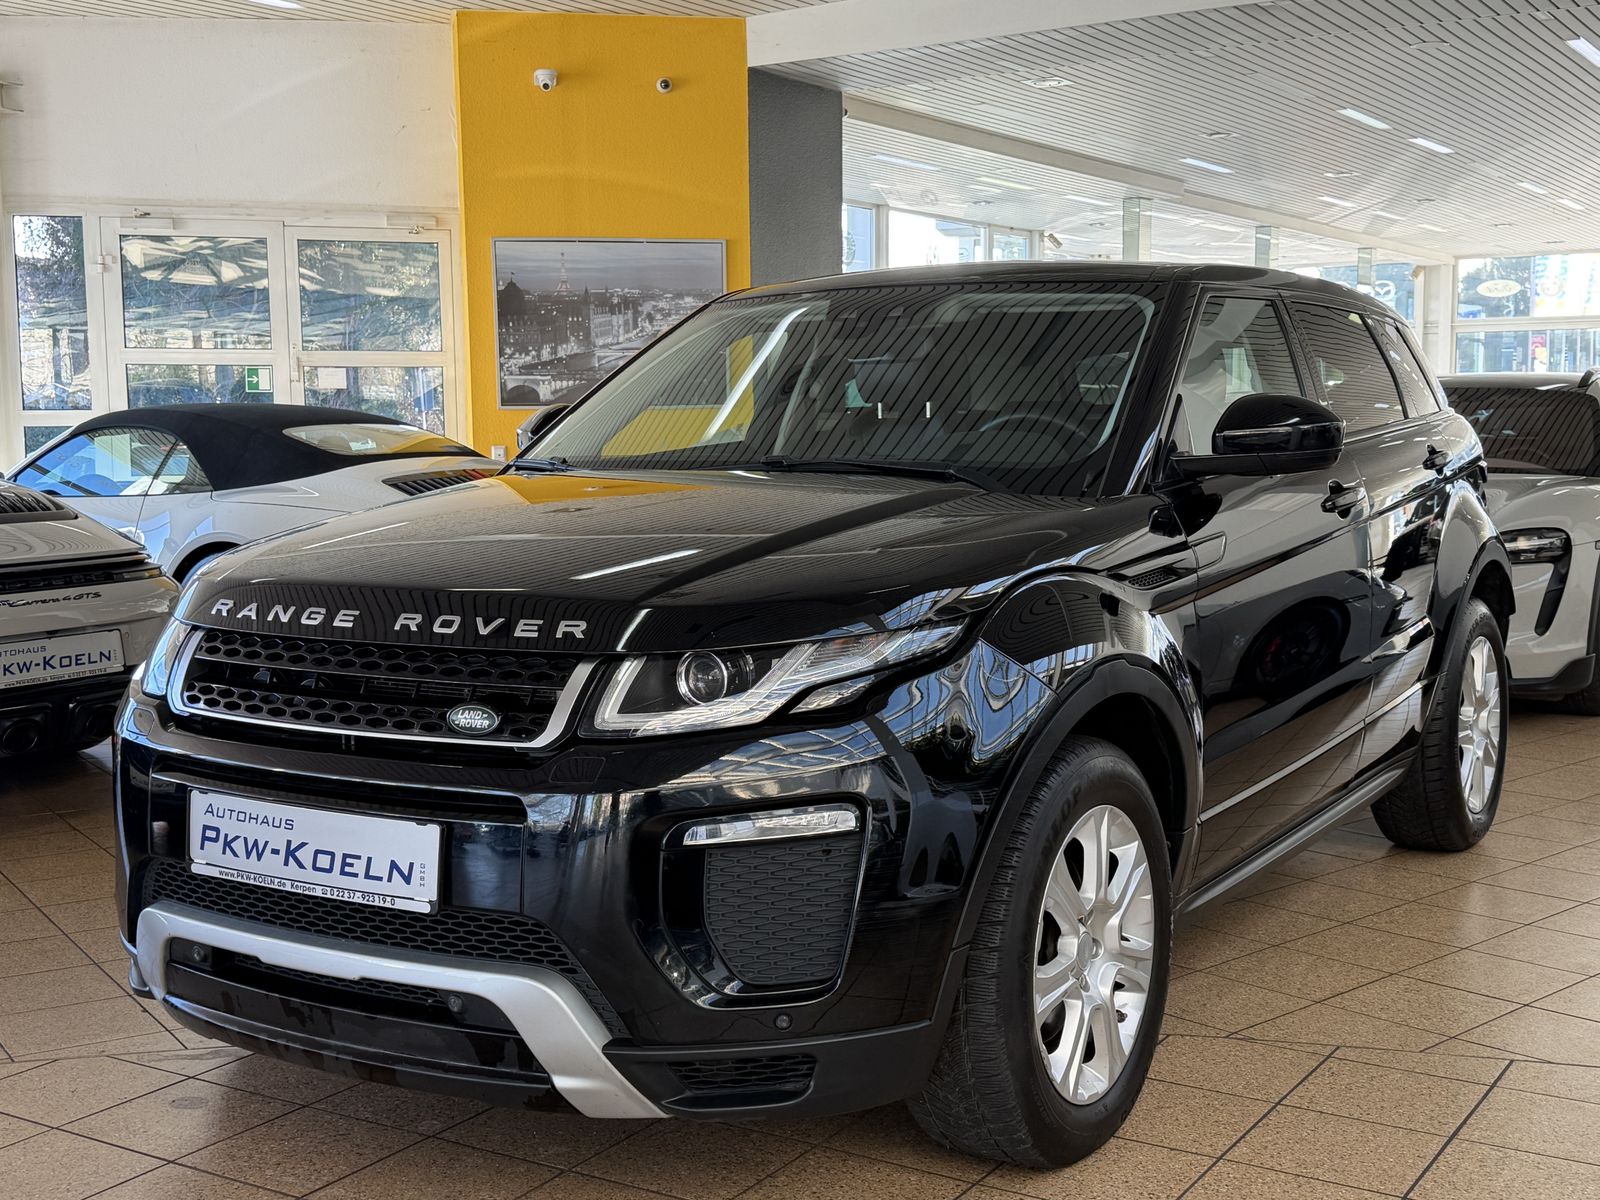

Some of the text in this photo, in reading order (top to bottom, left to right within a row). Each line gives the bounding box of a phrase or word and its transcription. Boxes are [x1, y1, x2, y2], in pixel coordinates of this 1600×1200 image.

[73, 591, 102, 601] GTS
[211, 598, 587, 639] RANGE ROVER
[0, 646, 47, 657] TOHAUS
[3, 650, 112, 677] KW-KOELN
[458, 710, 482, 719] LAND
[459, 719, 490, 728] ROVER
[204, 803, 295, 830] AUTOHAUS
[200, 824, 415, 886] PKW-KOELN
[218, 869, 287, 889] www.PKW-KOELN.de
[290, 881, 317, 895] Kerpen
